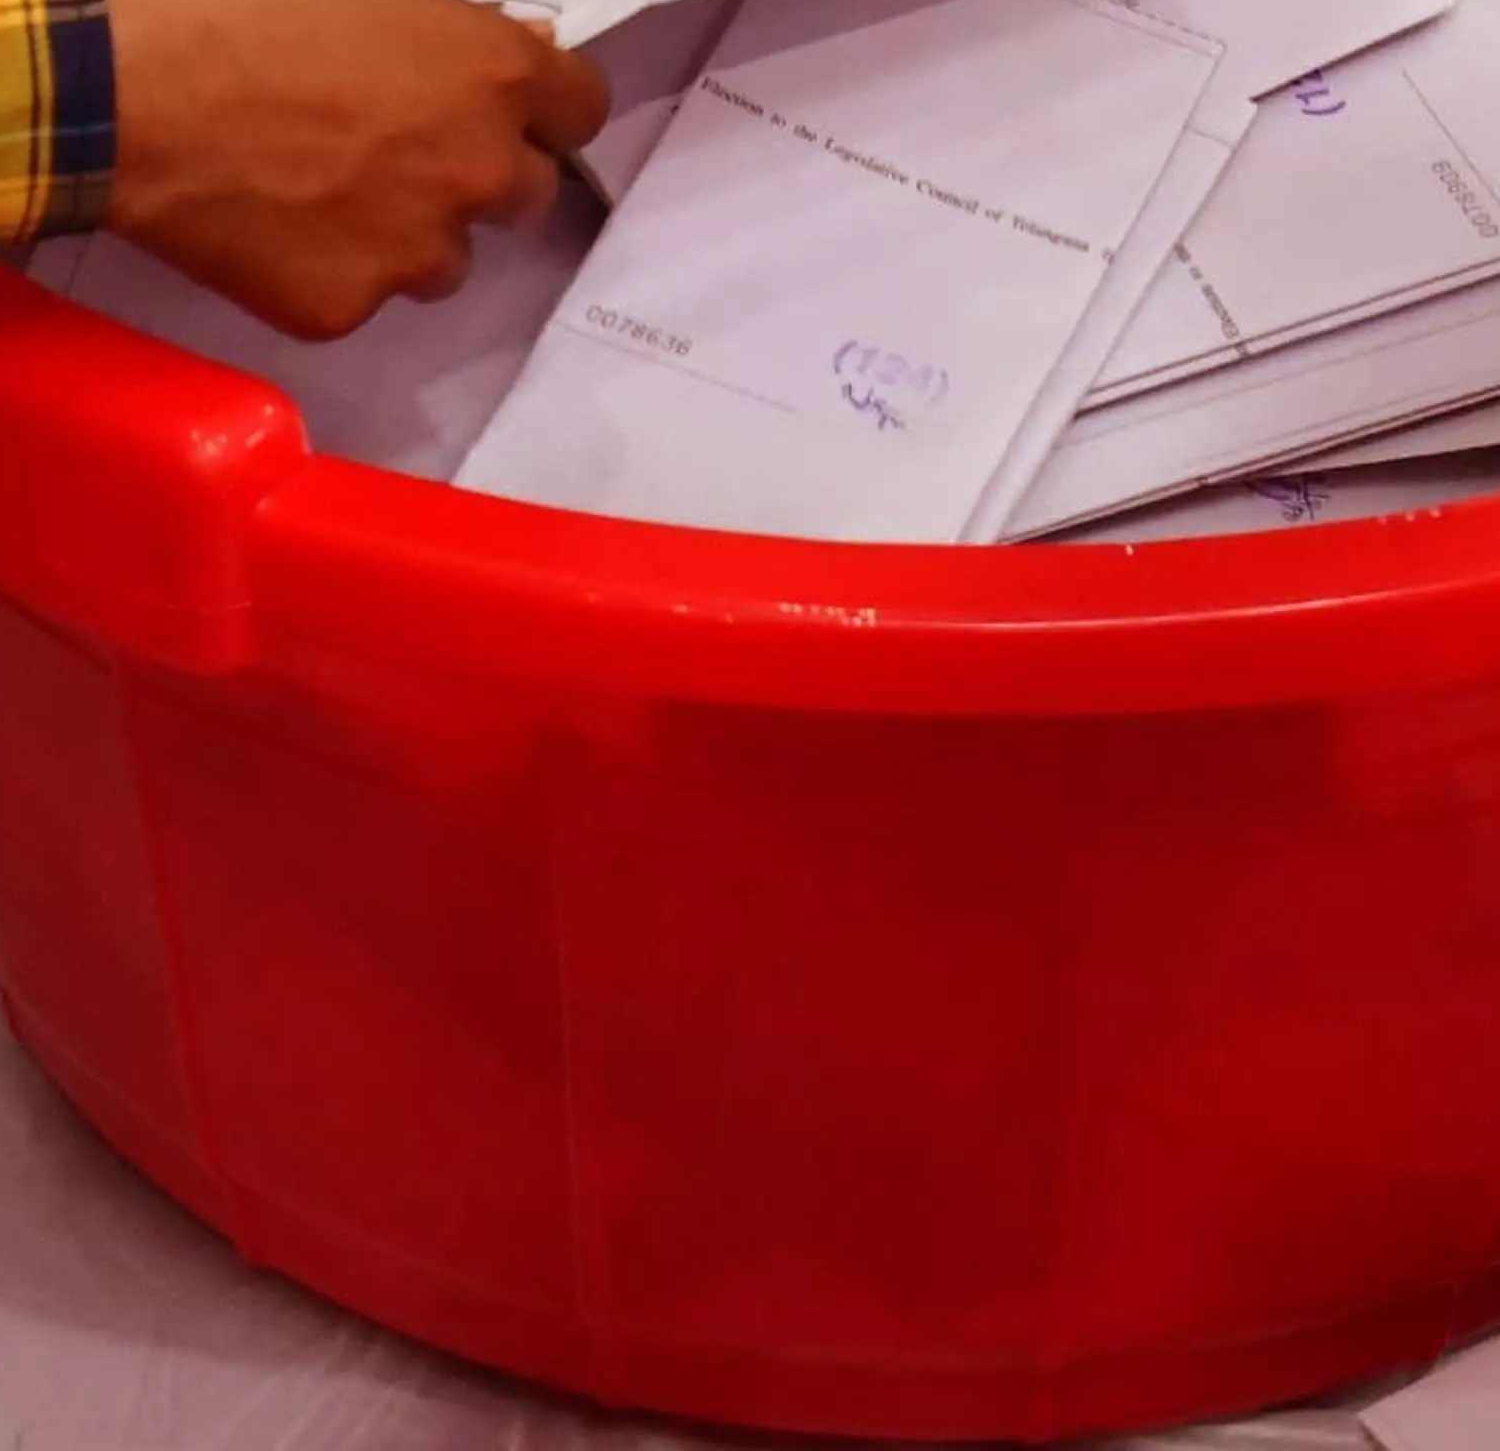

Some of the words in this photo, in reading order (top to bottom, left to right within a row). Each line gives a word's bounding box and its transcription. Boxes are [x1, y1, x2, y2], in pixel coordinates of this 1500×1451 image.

[700, 75, 767, 120] Election
[792, 117, 821, 144] the
[823, 133, 911, 188] Legislative
[915, 174, 981, 218] Council
[1010, 211, 1093, 256] Telangana
